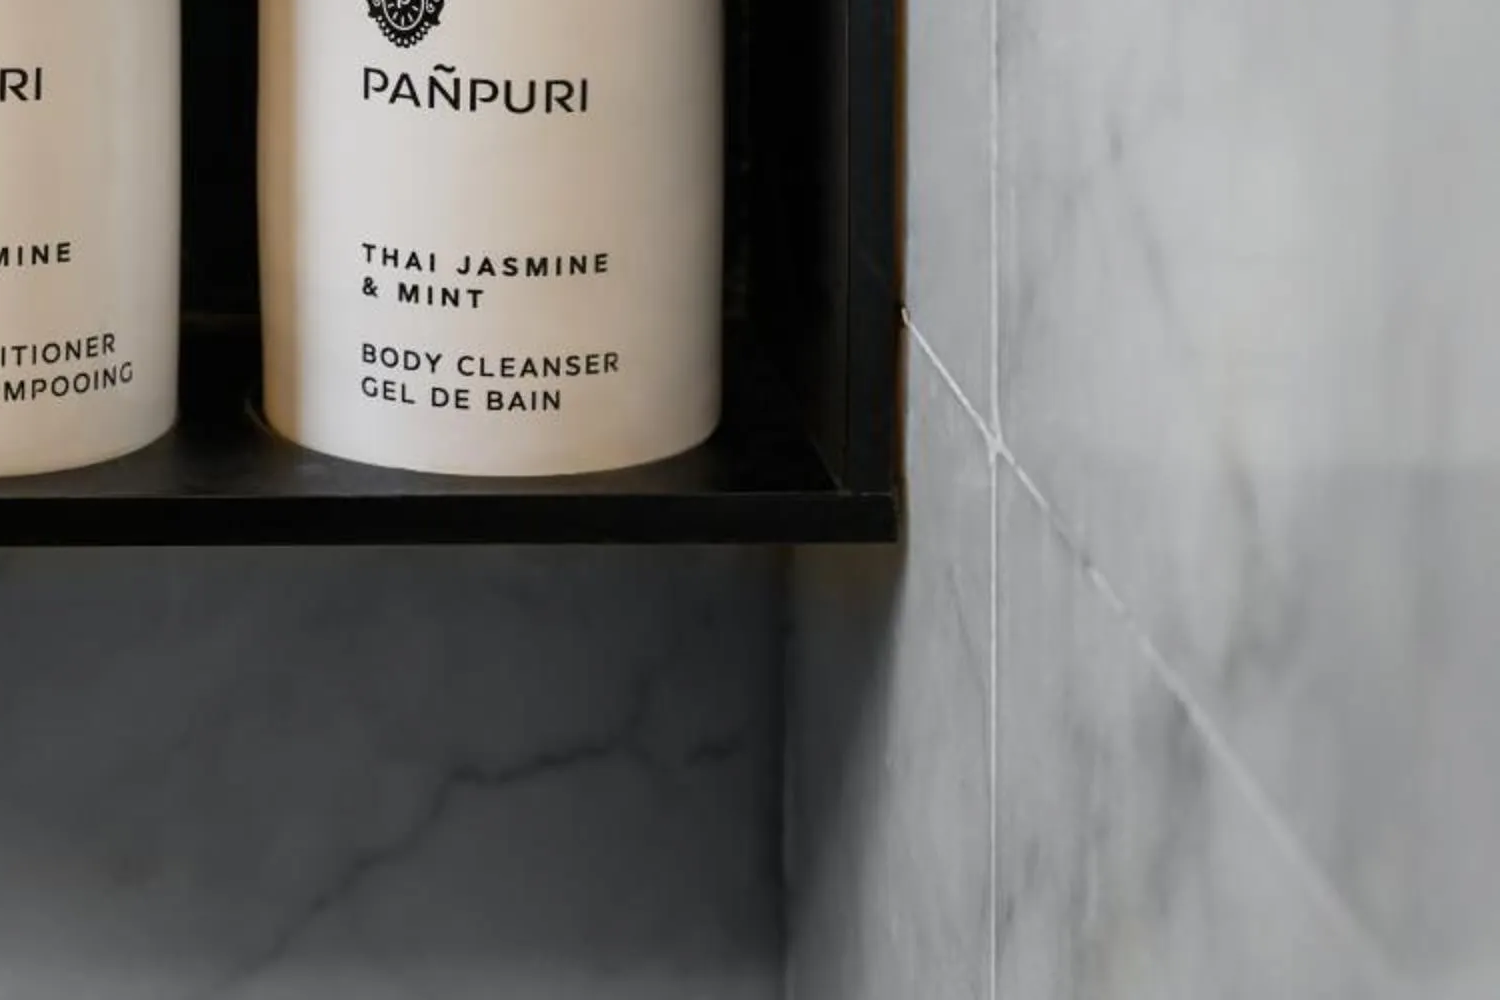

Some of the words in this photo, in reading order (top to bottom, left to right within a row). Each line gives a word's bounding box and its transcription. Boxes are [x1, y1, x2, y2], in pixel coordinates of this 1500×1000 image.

[363, 63, 588, 115] PAÑPURI
[361, 242, 436, 273] THAI
[456, 252, 610, 278] JASMINE
[362, 276, 379, 298] &
[397, 282, 485, 309] MINT
[361, 343, 443, 374] BODY
[457, 352, 620, 379] CLEANSER
[361, 376, 417, 405] GEL
[431, 387, 470, 411] DE
[486, 390, 561, 412] BAIN
